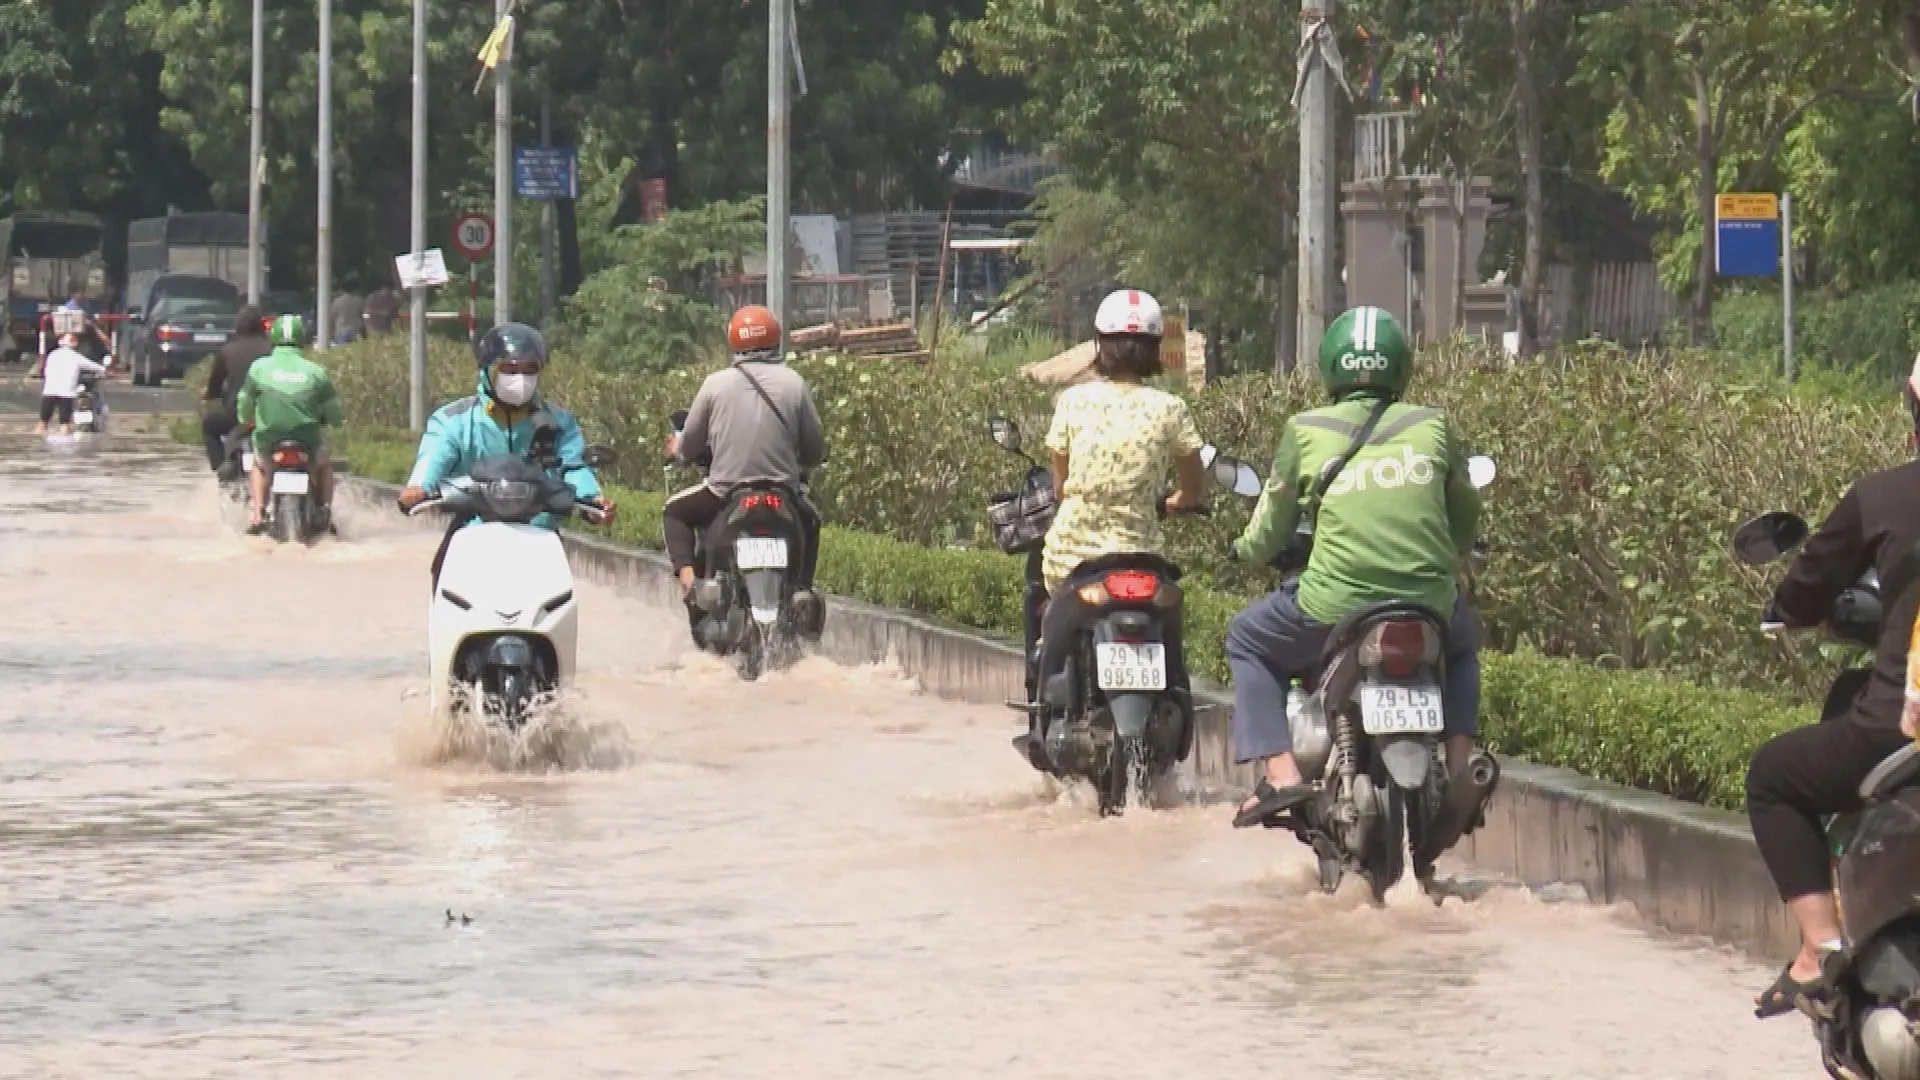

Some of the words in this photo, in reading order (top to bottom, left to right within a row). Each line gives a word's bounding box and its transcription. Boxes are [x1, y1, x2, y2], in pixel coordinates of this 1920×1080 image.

[466, 225, 484, 244] 30
[1341, 352, 1388, 370] Grab
[1375, 689, 1429, 707] 29-L5
